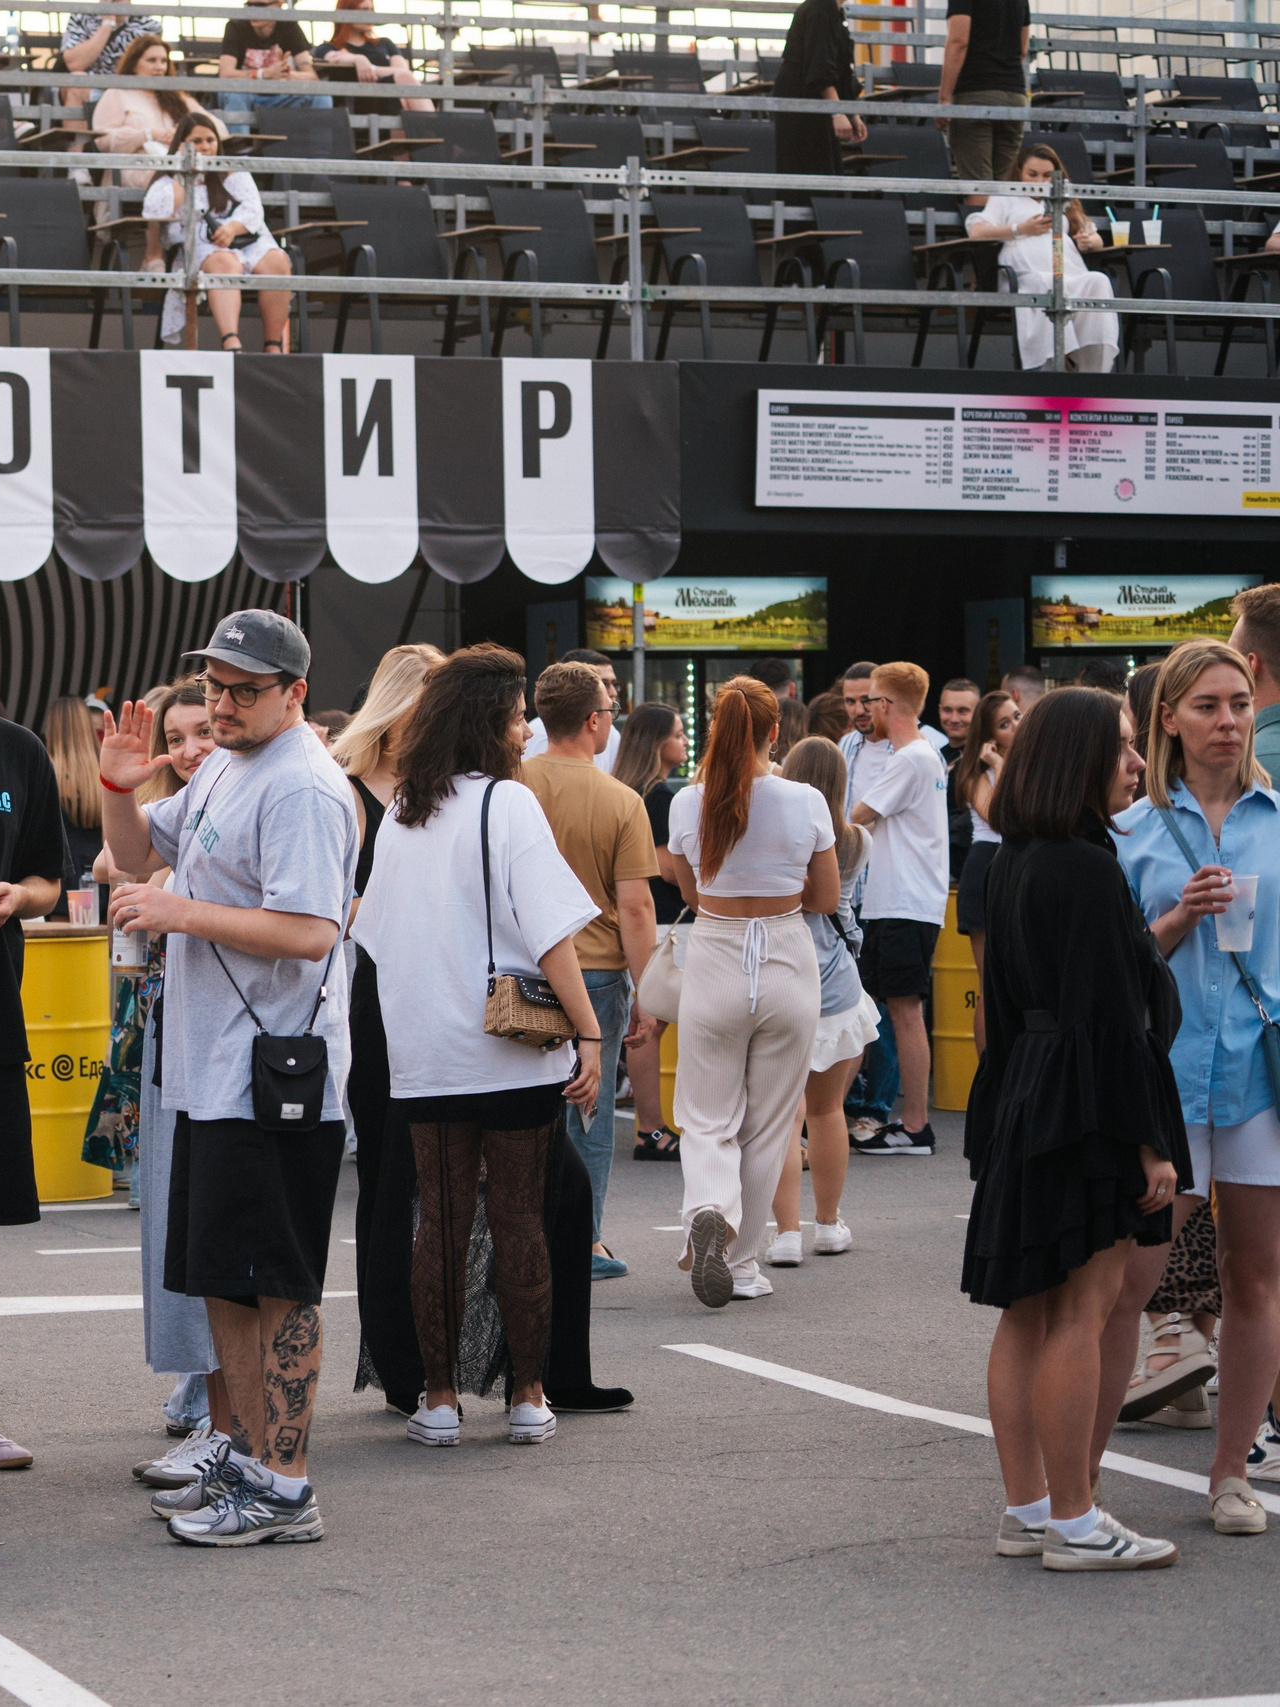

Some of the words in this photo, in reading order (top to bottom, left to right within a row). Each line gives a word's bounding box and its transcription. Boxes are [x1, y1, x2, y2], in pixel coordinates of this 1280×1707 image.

[963, 410, 992, 419] КРЕПКИЙ
[994, 412, 1027, 420] АЛКОГОЛЬ
[1069, 413, 1102, 422] КОКТЕЙЛИ
[1109, 415, 1133, 423] БАНКАХ
[1166, 416, 1184, 424] ПИВО
[675, 587, 737, 607] Мельник
[1117, 585, 1177, 604] Мельник
